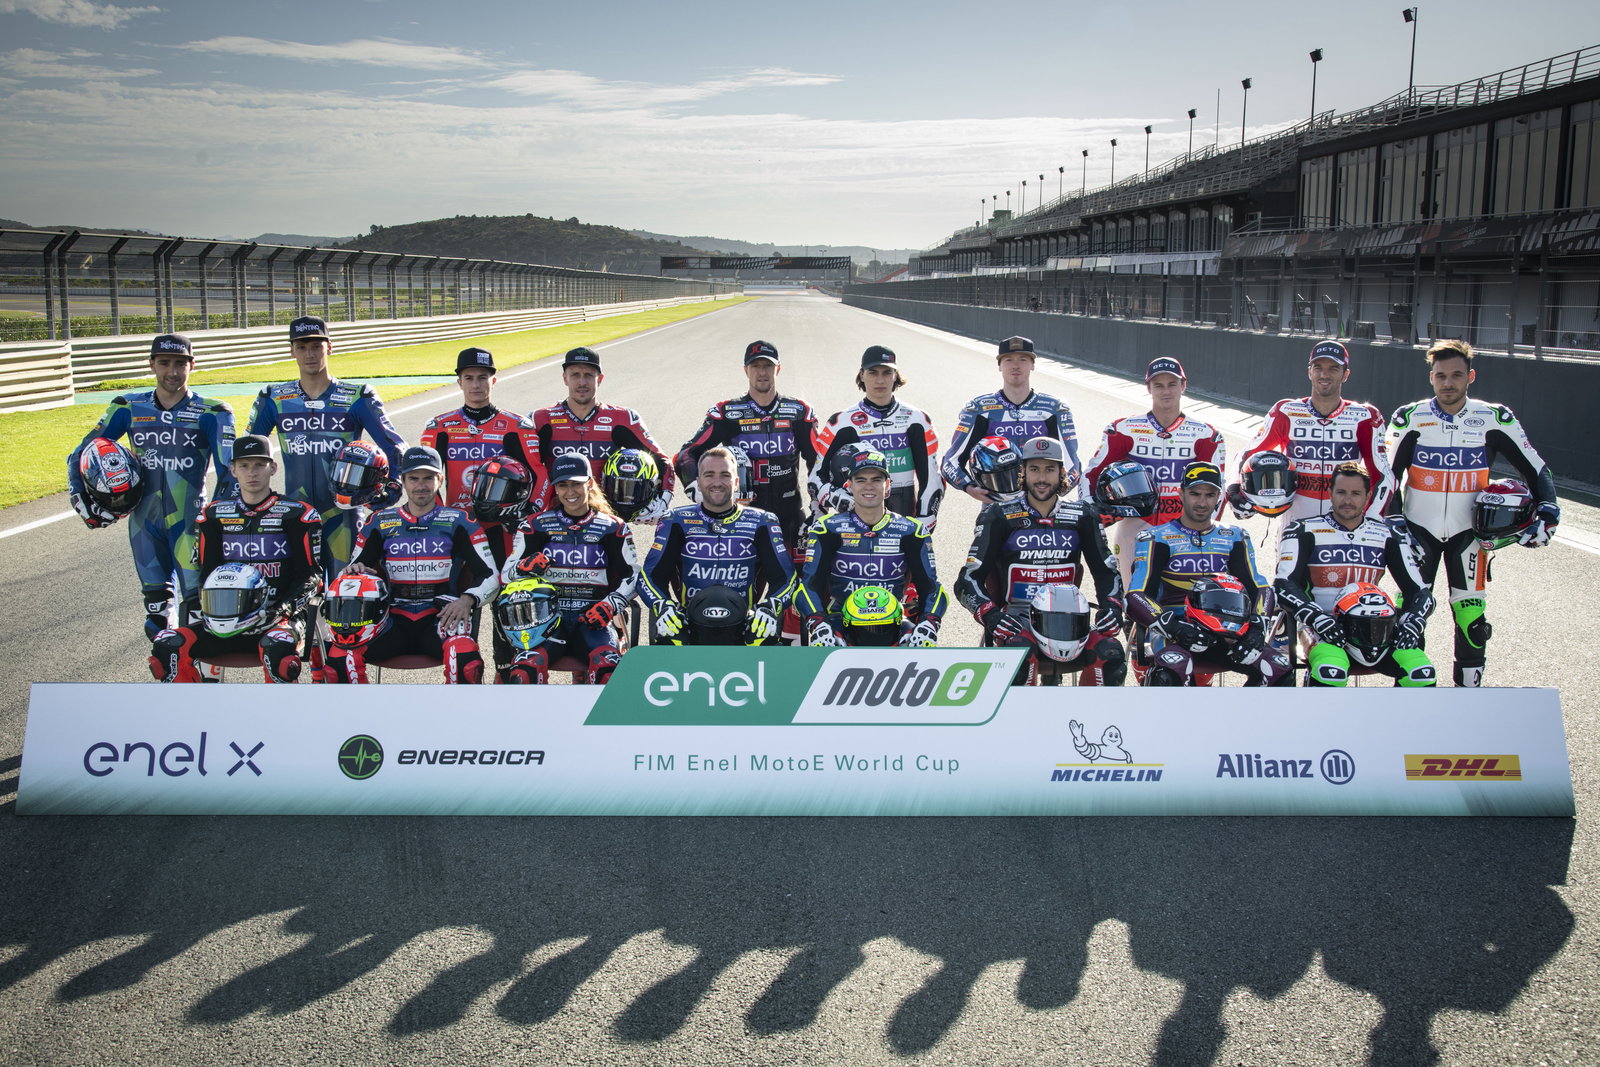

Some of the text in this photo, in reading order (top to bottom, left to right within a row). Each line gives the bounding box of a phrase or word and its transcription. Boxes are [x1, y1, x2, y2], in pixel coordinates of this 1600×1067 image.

[282, 413, 325, 430] enel
[995, 423, 1028, 436] enel
[133, 428, 176, 446] enel
[1294, 428, 1353, 439] OCTO
[285, 438, 343, 456] TRENTINO
[447, 444, 485, 459] enel
[552, 441, 594, 458] enel
[738, 436, 782, 454] enel
[1136, 445, 1191, 457] OCTO
[1294, 443, 1336, 459] enel
[1000, 453, 1014, 462] SHOEI
[1417, 448, 1463, 467] enel
[1442, 472, 1477, 491] IVAR
[223, 536, 266, 557] enel
[389, 538, 427, 554] enel
[686, 539, 732, 557] enel
[1016, 532, 1057, 548] enel
[544, 546, 588, 566] enel
[1020, 550, 1071, 560] DYNAVOLT
[1169, 554, 1215, 572] enel
[1318, 549, 1364, 564] enel
[688, 563, 749, 580] Avintia
[835, 558, 884, 577] enel
[1468, 552, 1477, 580] LCR
[1218, 577, 1242, 587] SHARK
[509, 591, 531, 600] Airoh
[1279, 588, 1302, 608] LCR
[1361, 596, 1384, 604] 14
[704, 607, 729, 617] KYT
[858, 606, 887, 614] SHARK
[1421, 597, 1433, 617] LCR
[351, 619, 373, 627] PULL&BEAR
[643, 661, 767, 707] enel
[83, 731, 207, 777] enel
[634, 754, 960, 775] FIM Enel MotoE World Cup
[1215, 753, 1313, 778] Allianz
[1421, 758, 1506, 777] DHL
[1050, 768, 1163, 782] MICHELIN
